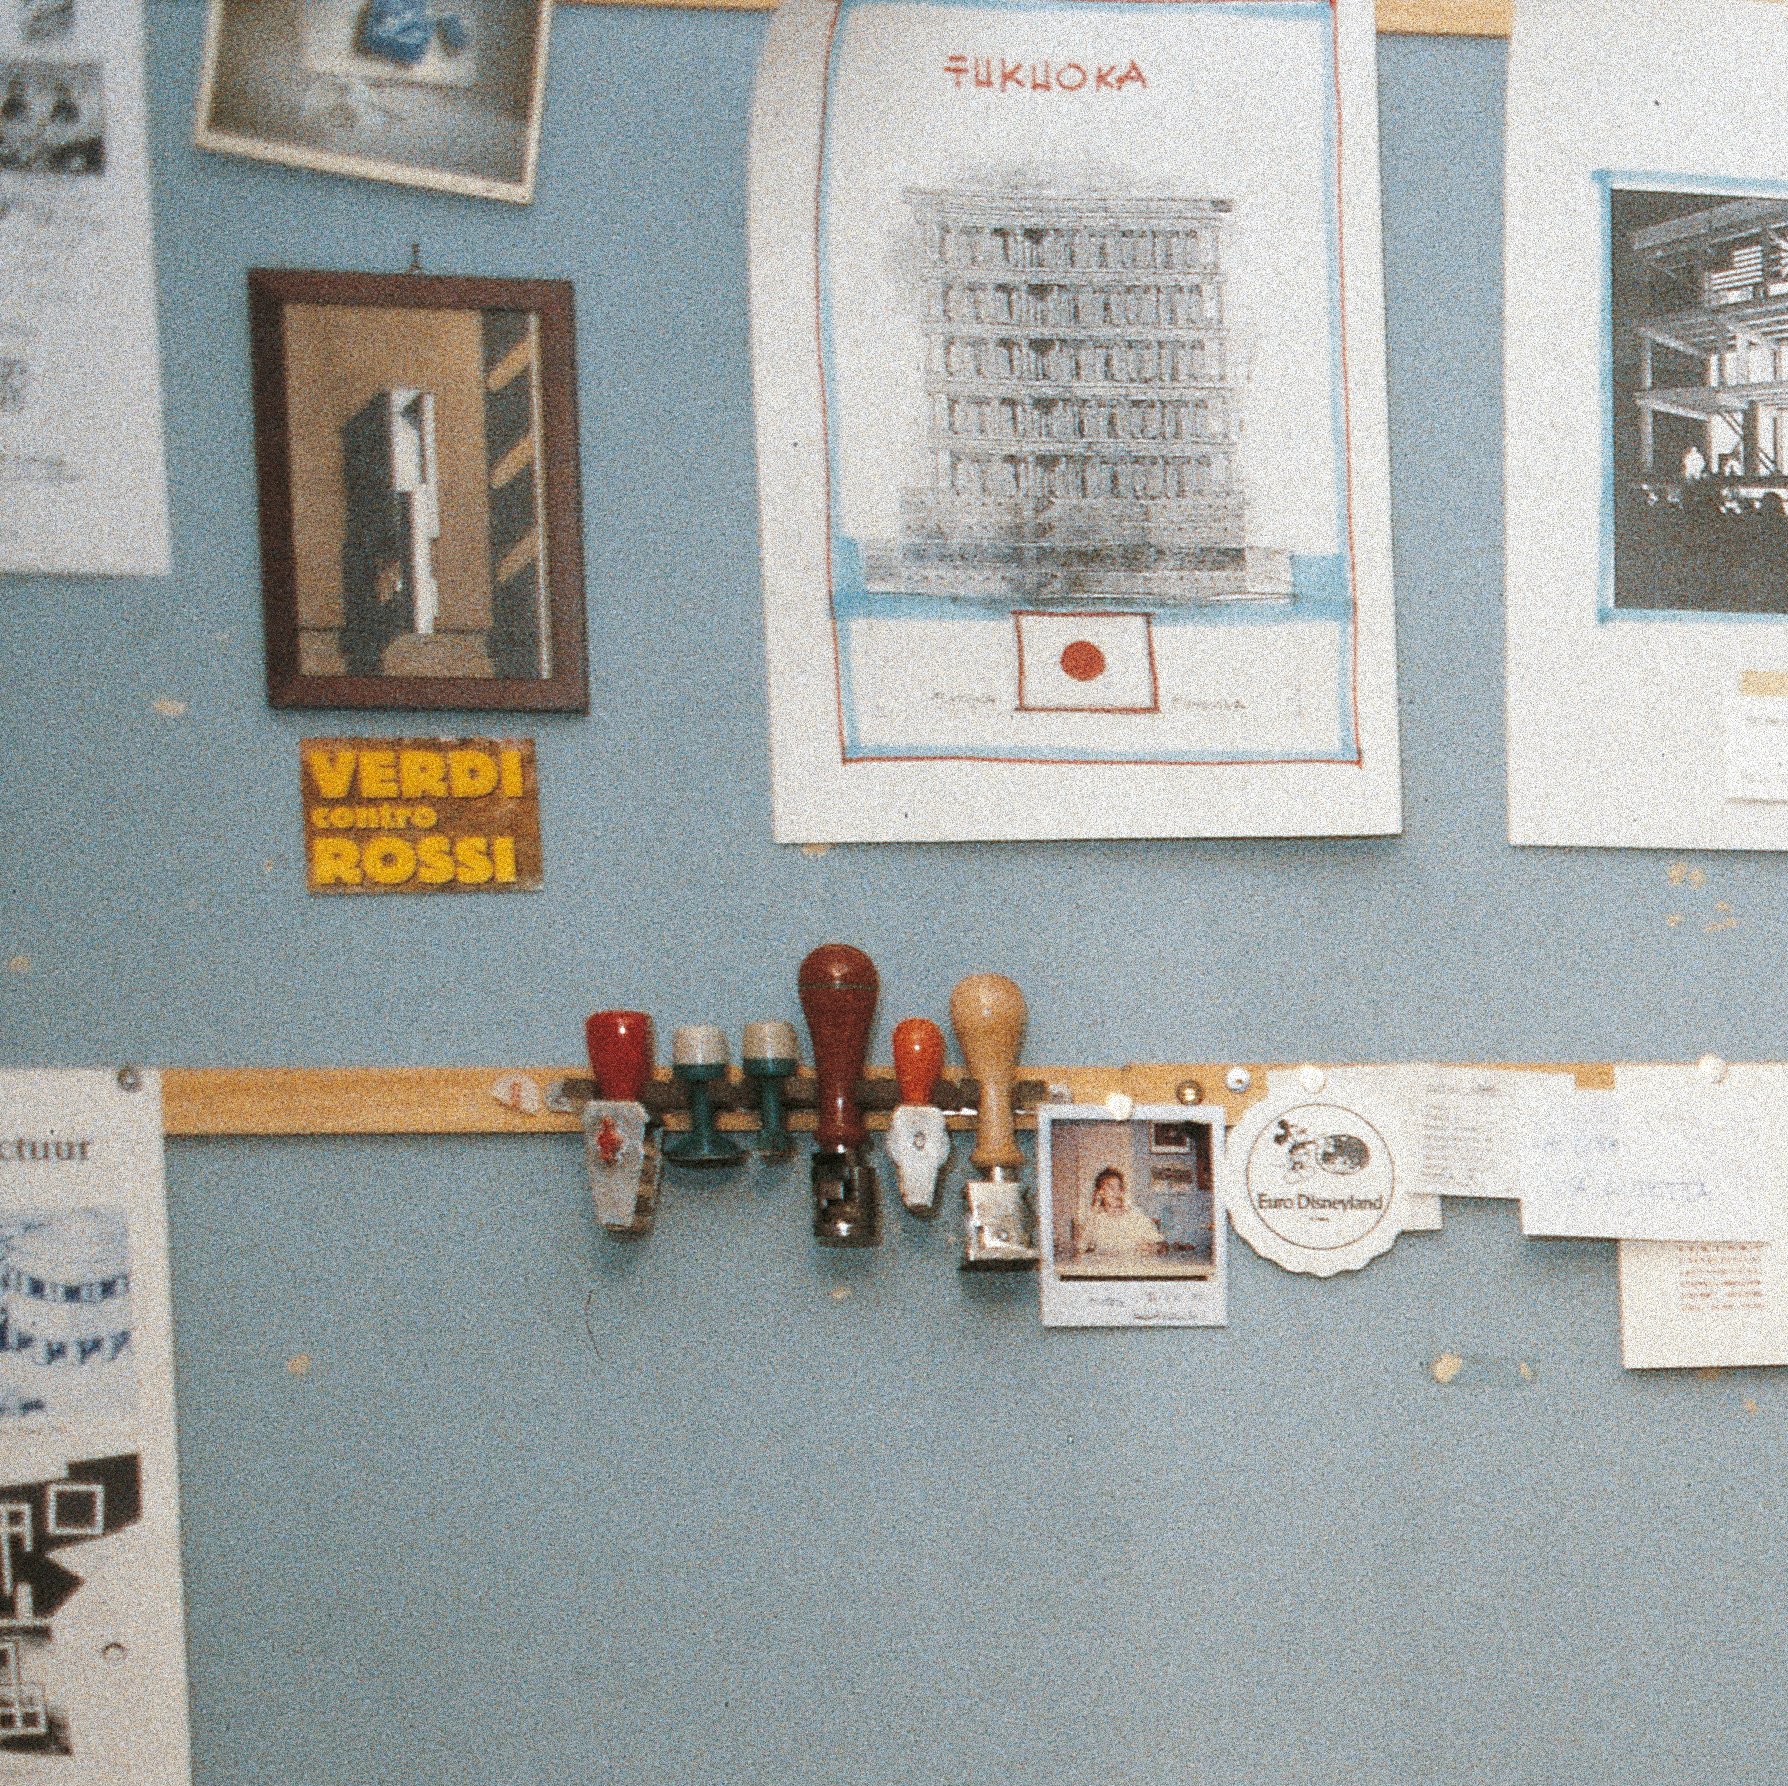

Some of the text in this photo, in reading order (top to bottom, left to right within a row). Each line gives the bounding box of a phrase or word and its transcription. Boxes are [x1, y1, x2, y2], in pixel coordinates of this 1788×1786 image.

[943, 54, 1148, 93] FUKUOKA
[309, 748, 524, 800] VERDI
[310, 803, 438, 831] contro
[308, 835, 517, 886] ROSSI
[1257, 1191, 1384, 1214] Euro Disneyland
